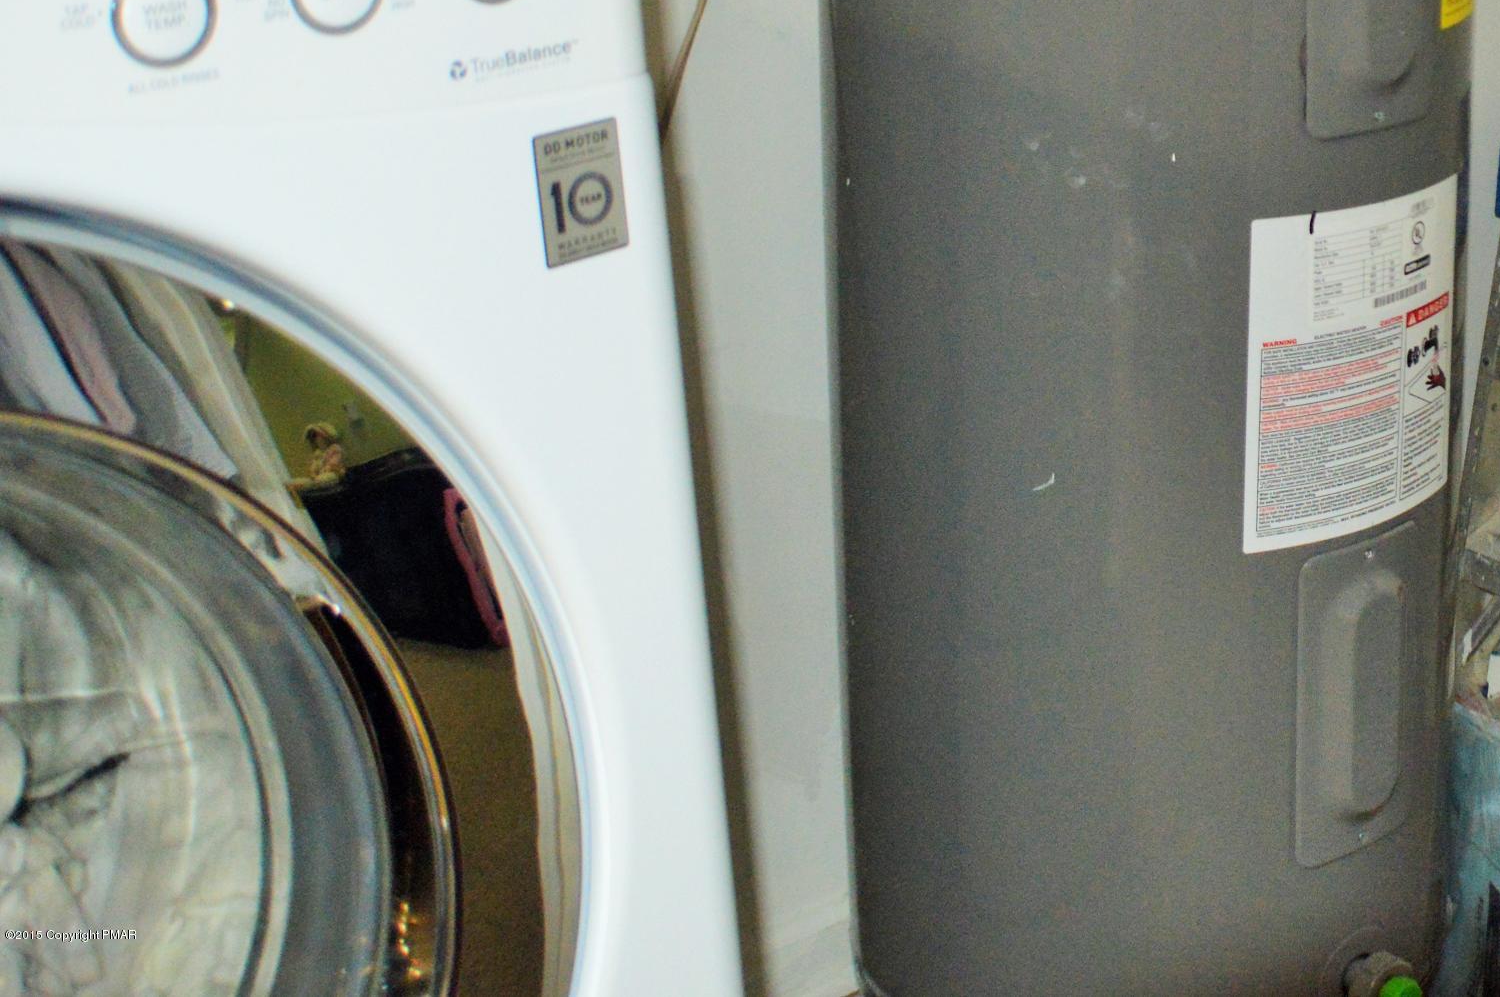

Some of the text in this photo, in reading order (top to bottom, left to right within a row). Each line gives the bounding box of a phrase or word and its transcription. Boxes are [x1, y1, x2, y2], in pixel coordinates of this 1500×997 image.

[142, 0, 188, 17] WASH
[543, 140, 561, 156] DD
[564, 128, 610, 150] MOTOR
[550, 170, 614, 235] 10
[579, 193, 603, 207] YEAR
[557, 225, 618, 252] WARRANTY
[1262, 338, 1297, 349] WARNING
